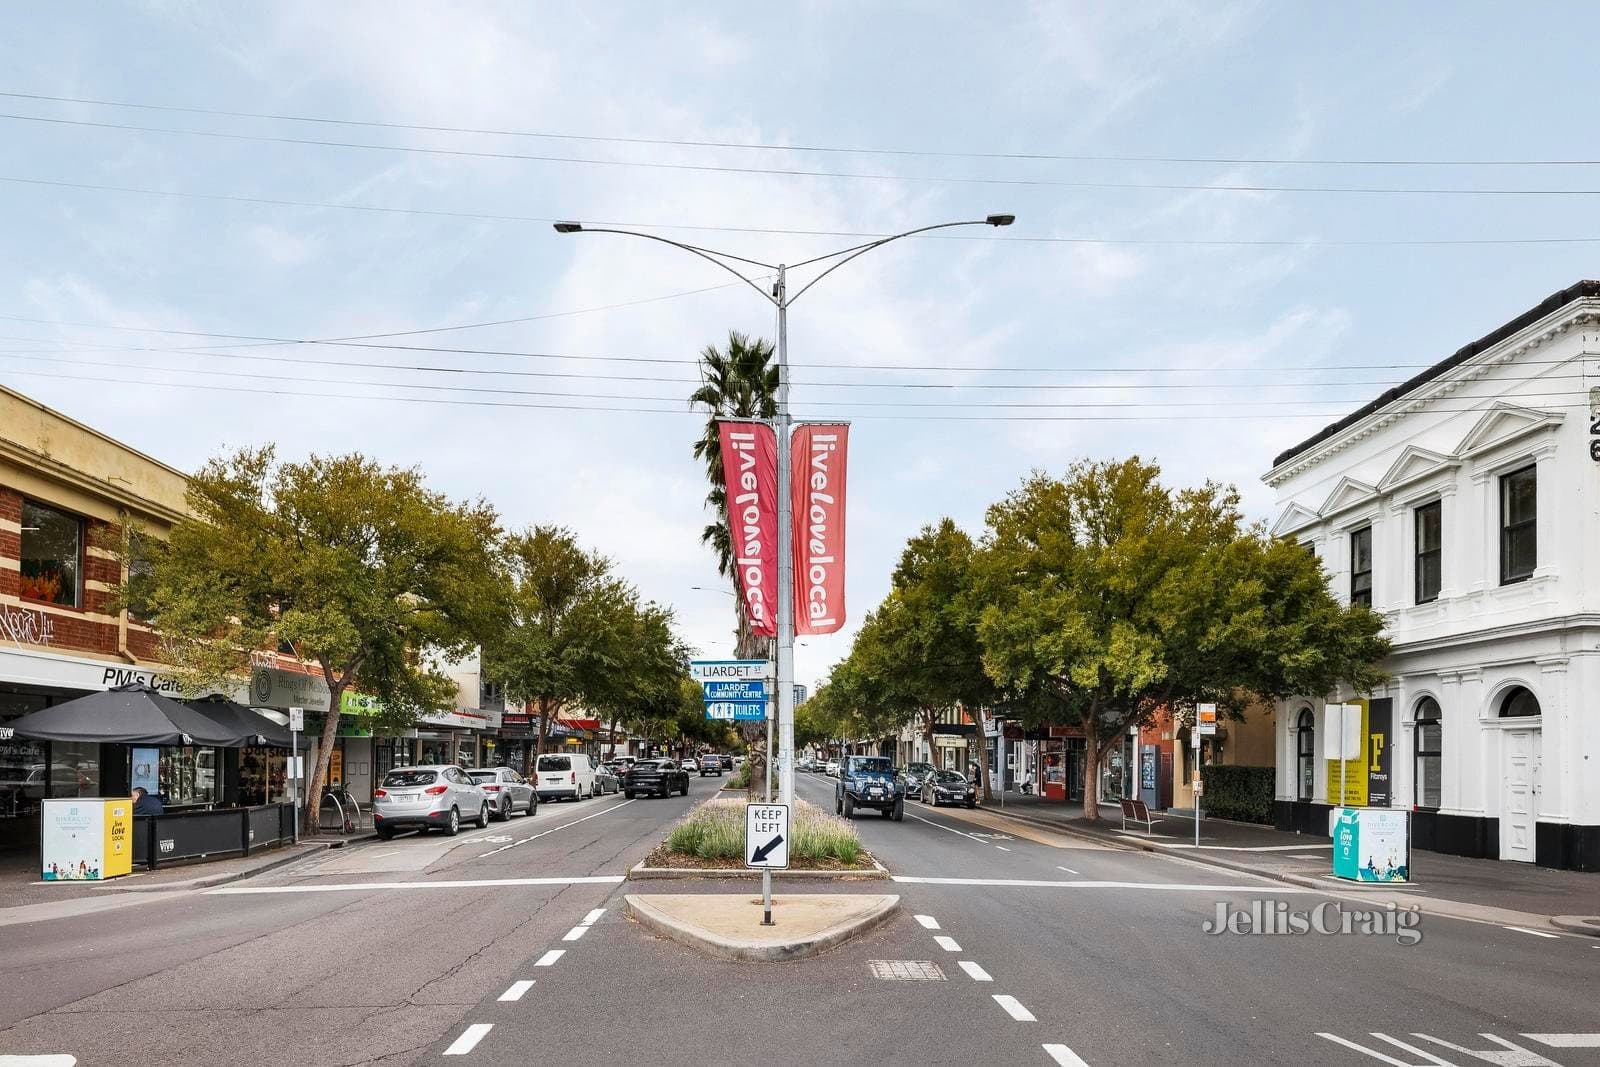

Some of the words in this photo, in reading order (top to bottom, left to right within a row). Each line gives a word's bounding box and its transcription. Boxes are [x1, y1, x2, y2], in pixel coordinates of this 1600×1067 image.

[102, 668, 145, 686] PM's
[703, 666, 751, 677] LIARDET
[717, 683, 750, 691] LIARDET
[735, 704, 760, 715] TOILETS
[1371, 734, 1384, 771] F
[754, 809, 782, 820] KEEP
[755, 822, 781, 833] LEFT
